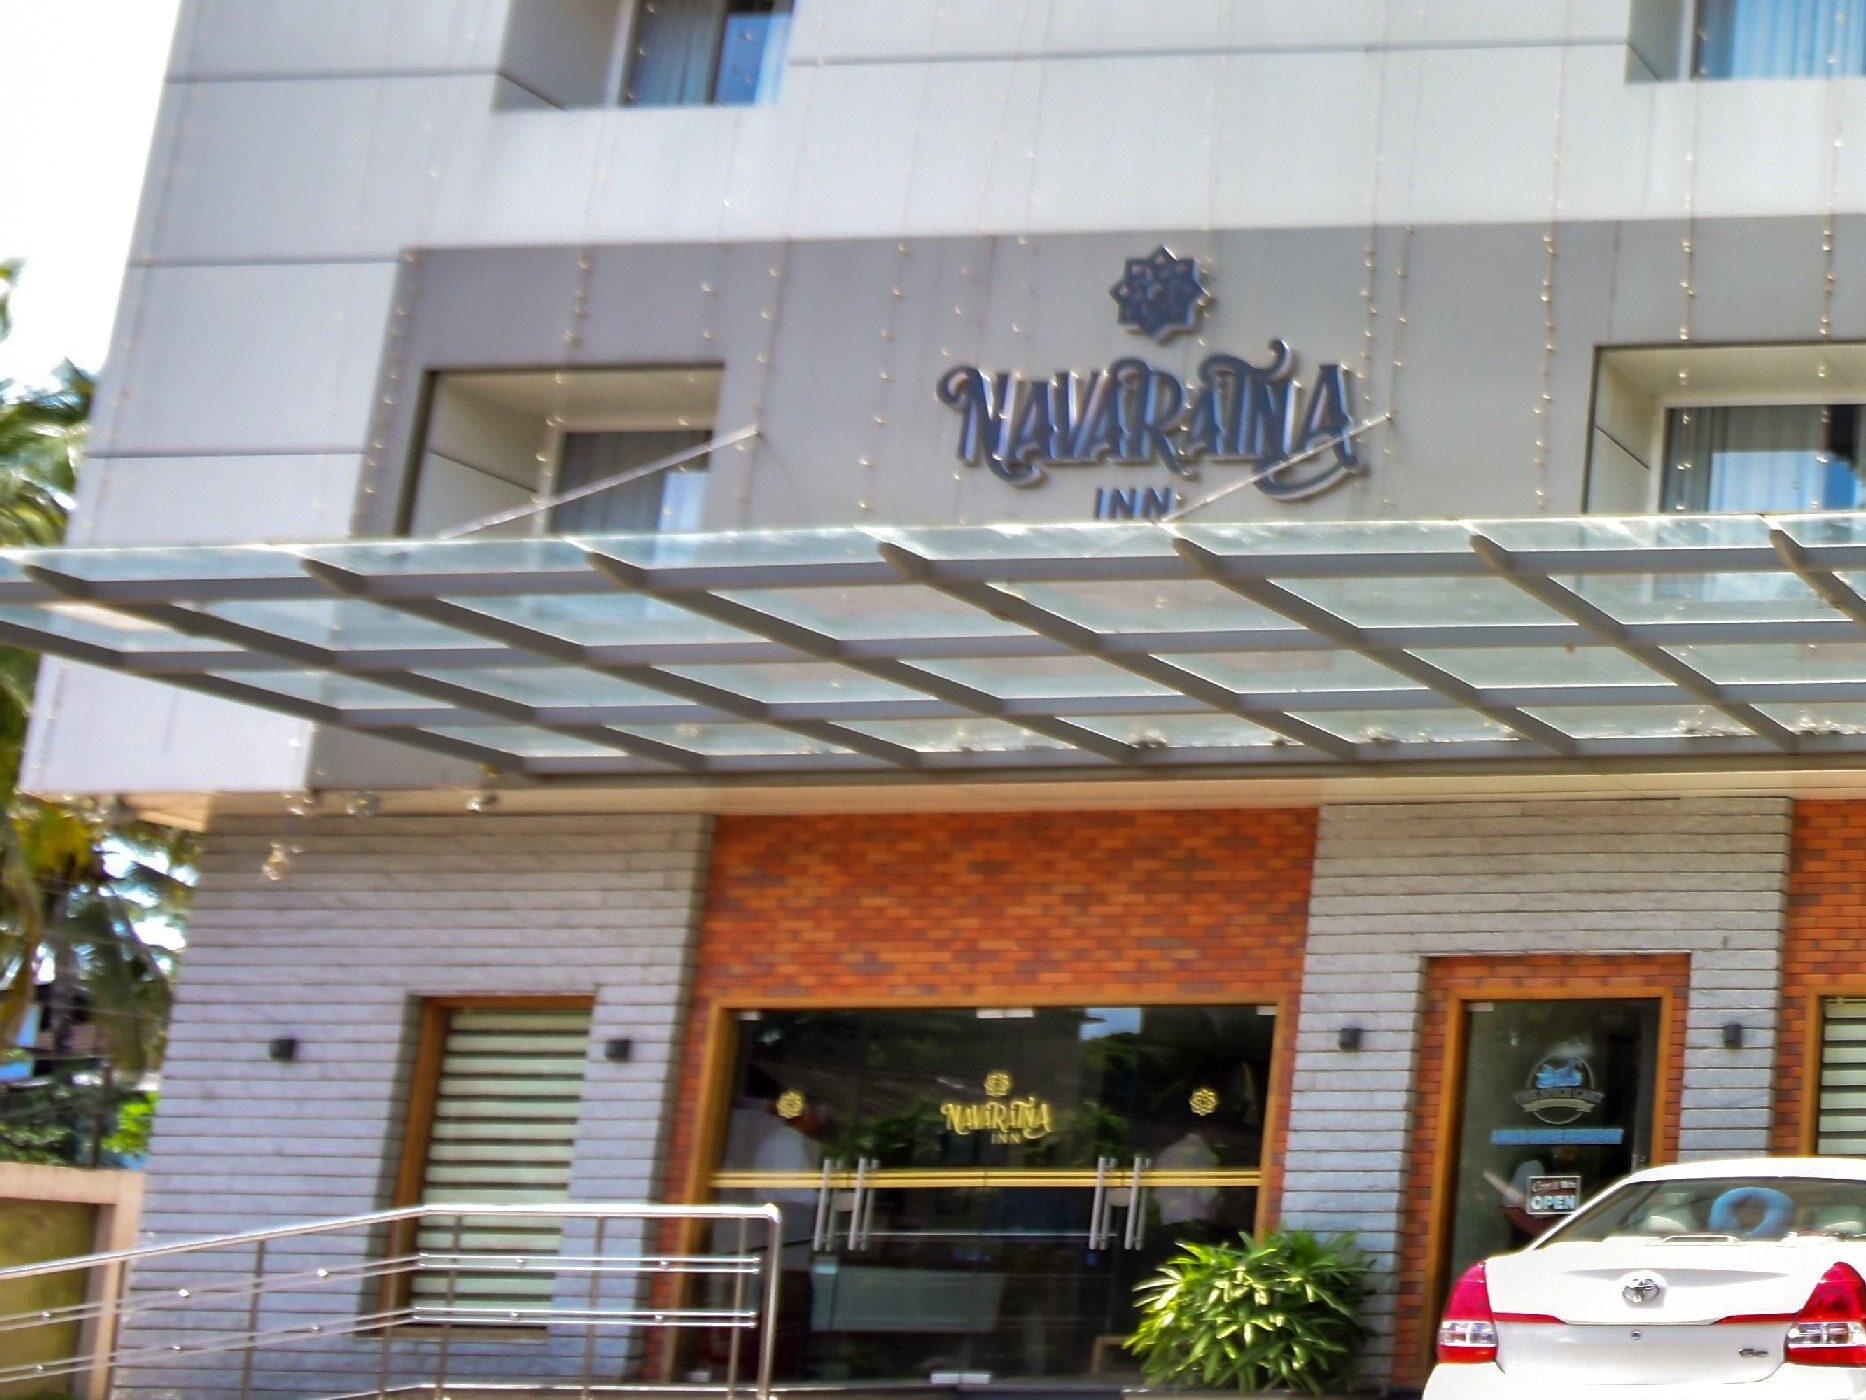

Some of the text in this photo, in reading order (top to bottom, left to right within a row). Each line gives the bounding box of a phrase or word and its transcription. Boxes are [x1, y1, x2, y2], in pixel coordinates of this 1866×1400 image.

[936, 338, 1367, 500] NAVARATNA
[1095, 487, 1177, 521] INN
[940, 1096, 1052, 1139] NAVARATNA
[991, 1132, 1021, 1145] INN
[1531, 1195, 1576, 1210] OPEN
